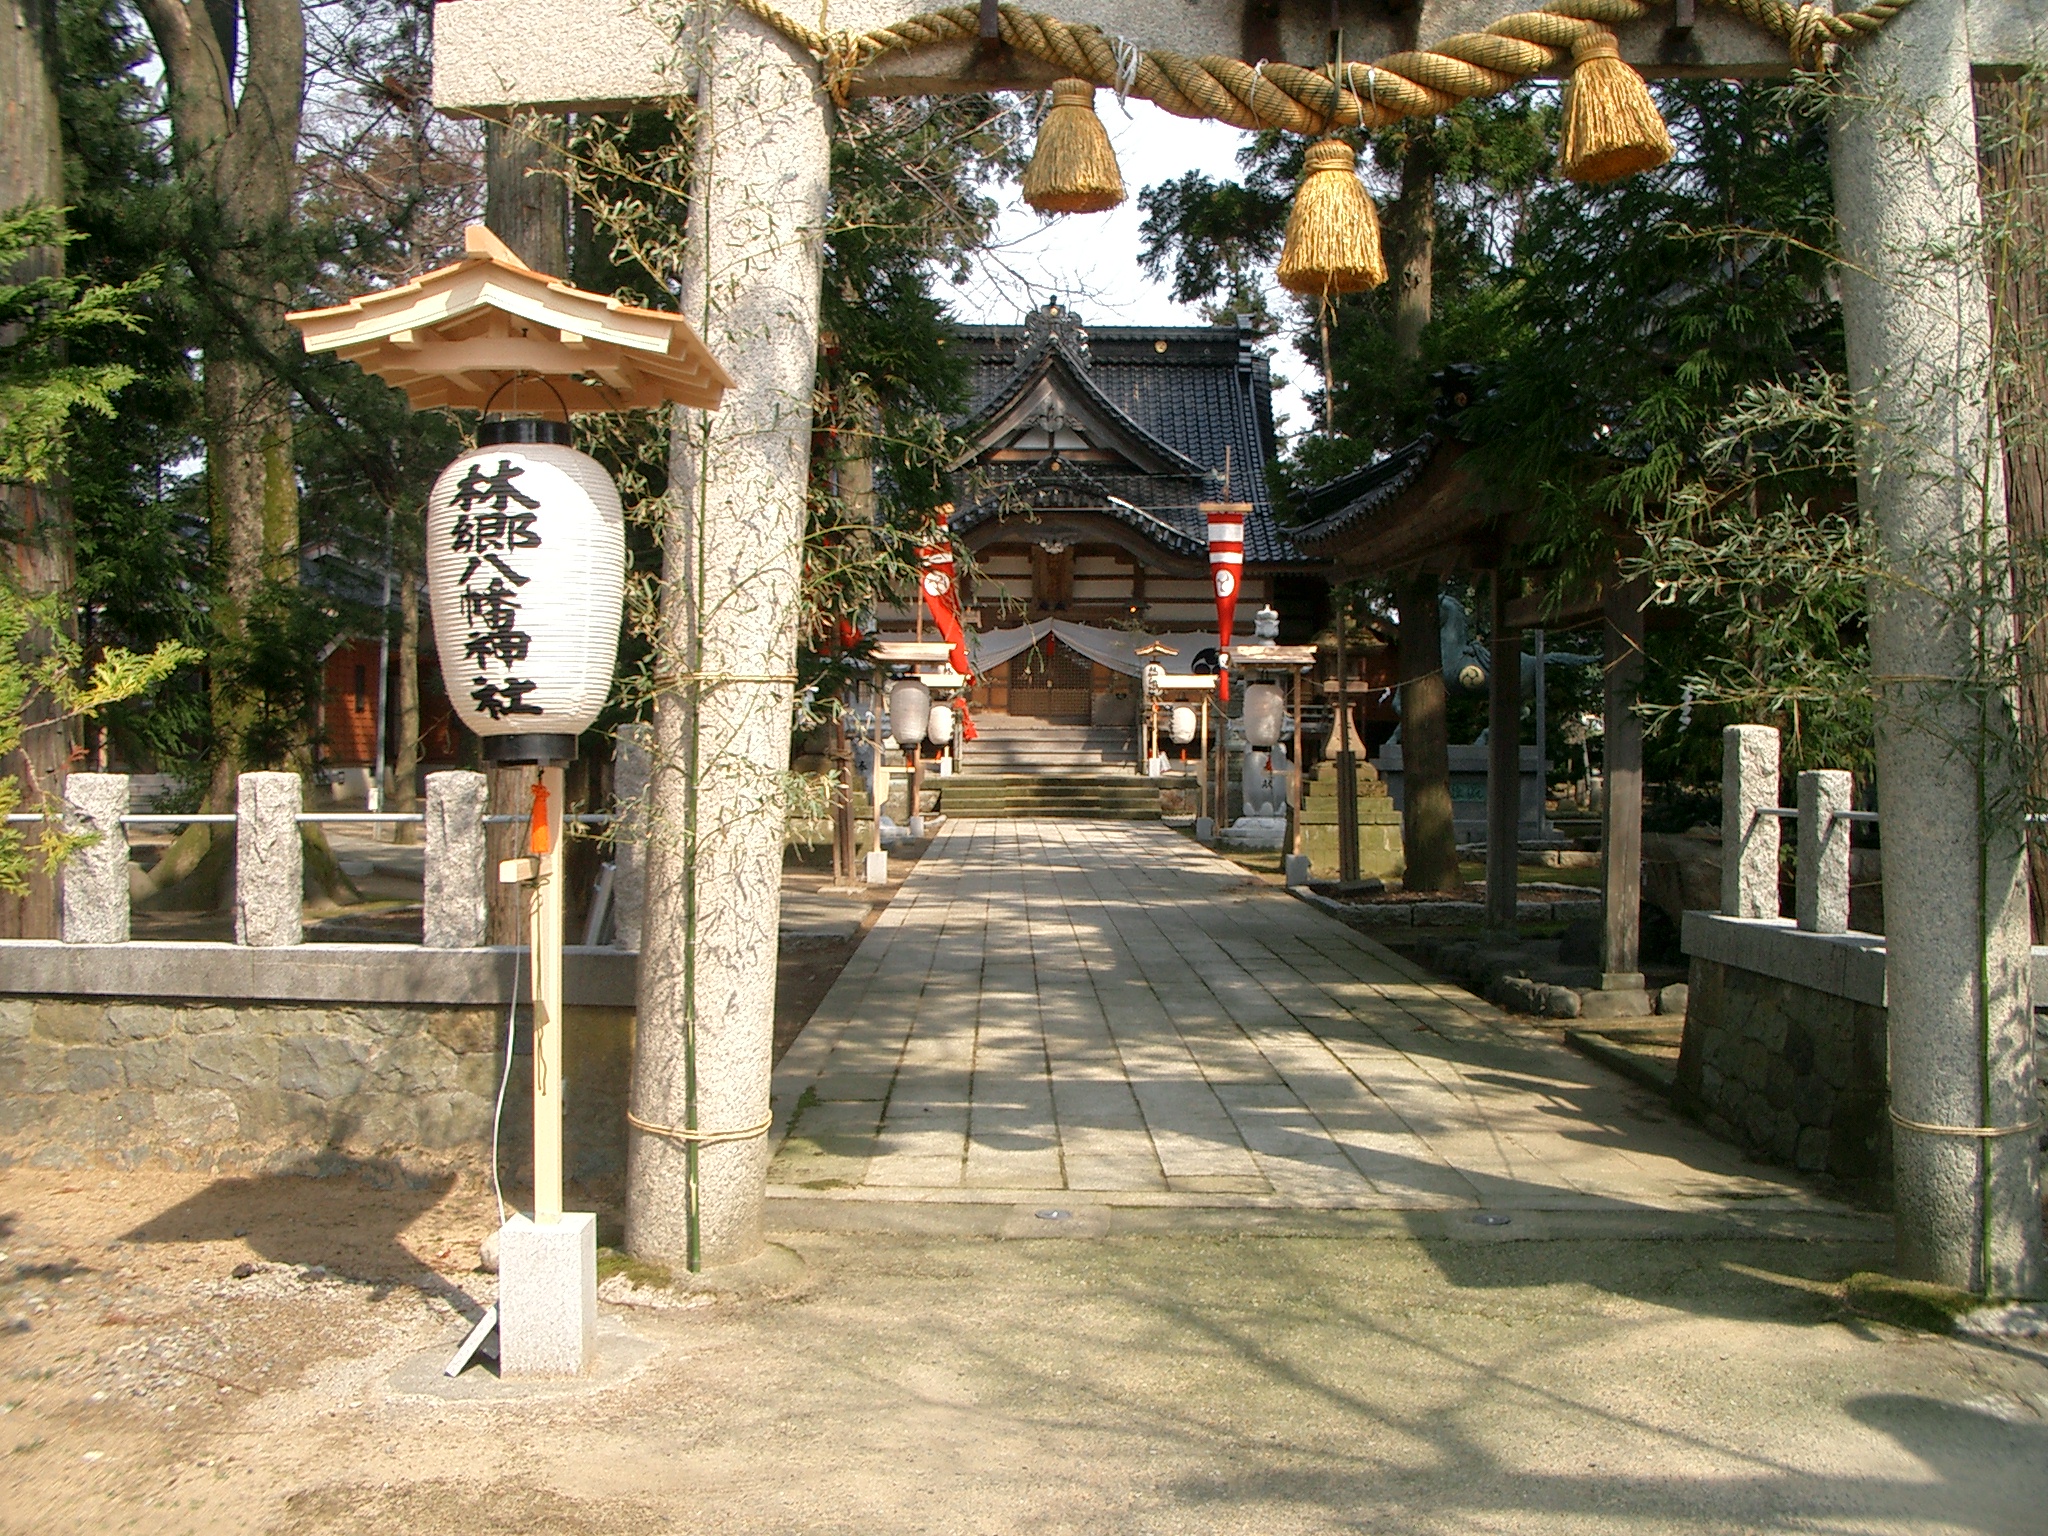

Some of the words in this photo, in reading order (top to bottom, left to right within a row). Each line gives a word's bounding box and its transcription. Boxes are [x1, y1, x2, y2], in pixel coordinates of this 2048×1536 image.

[450, 459, 544, 720] 林郷八幡神社
